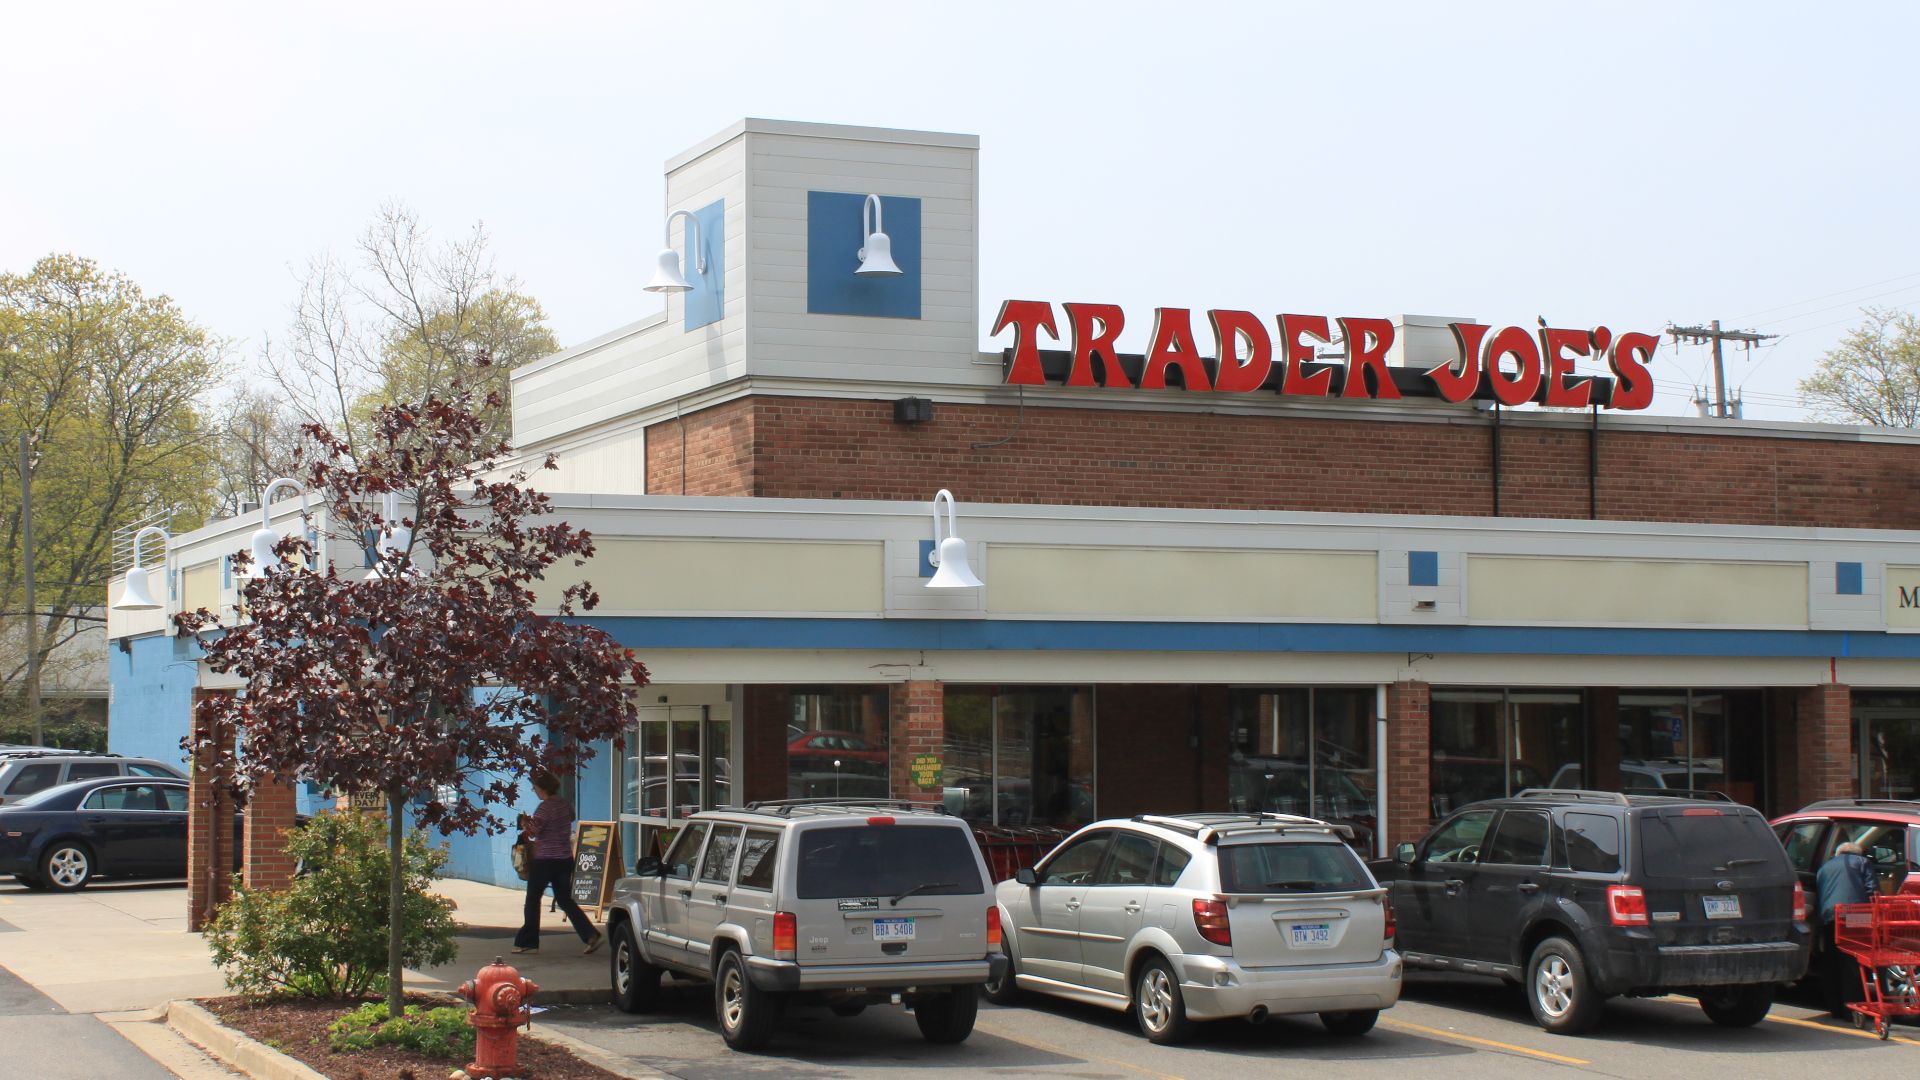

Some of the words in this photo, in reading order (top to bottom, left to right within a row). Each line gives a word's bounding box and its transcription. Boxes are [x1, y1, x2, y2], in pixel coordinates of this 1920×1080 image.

[990, 299, 1401, 399] TRADER
[1424, 322, 1662, 410] JOE'S
[809, 936, 829, 945] Jeep
